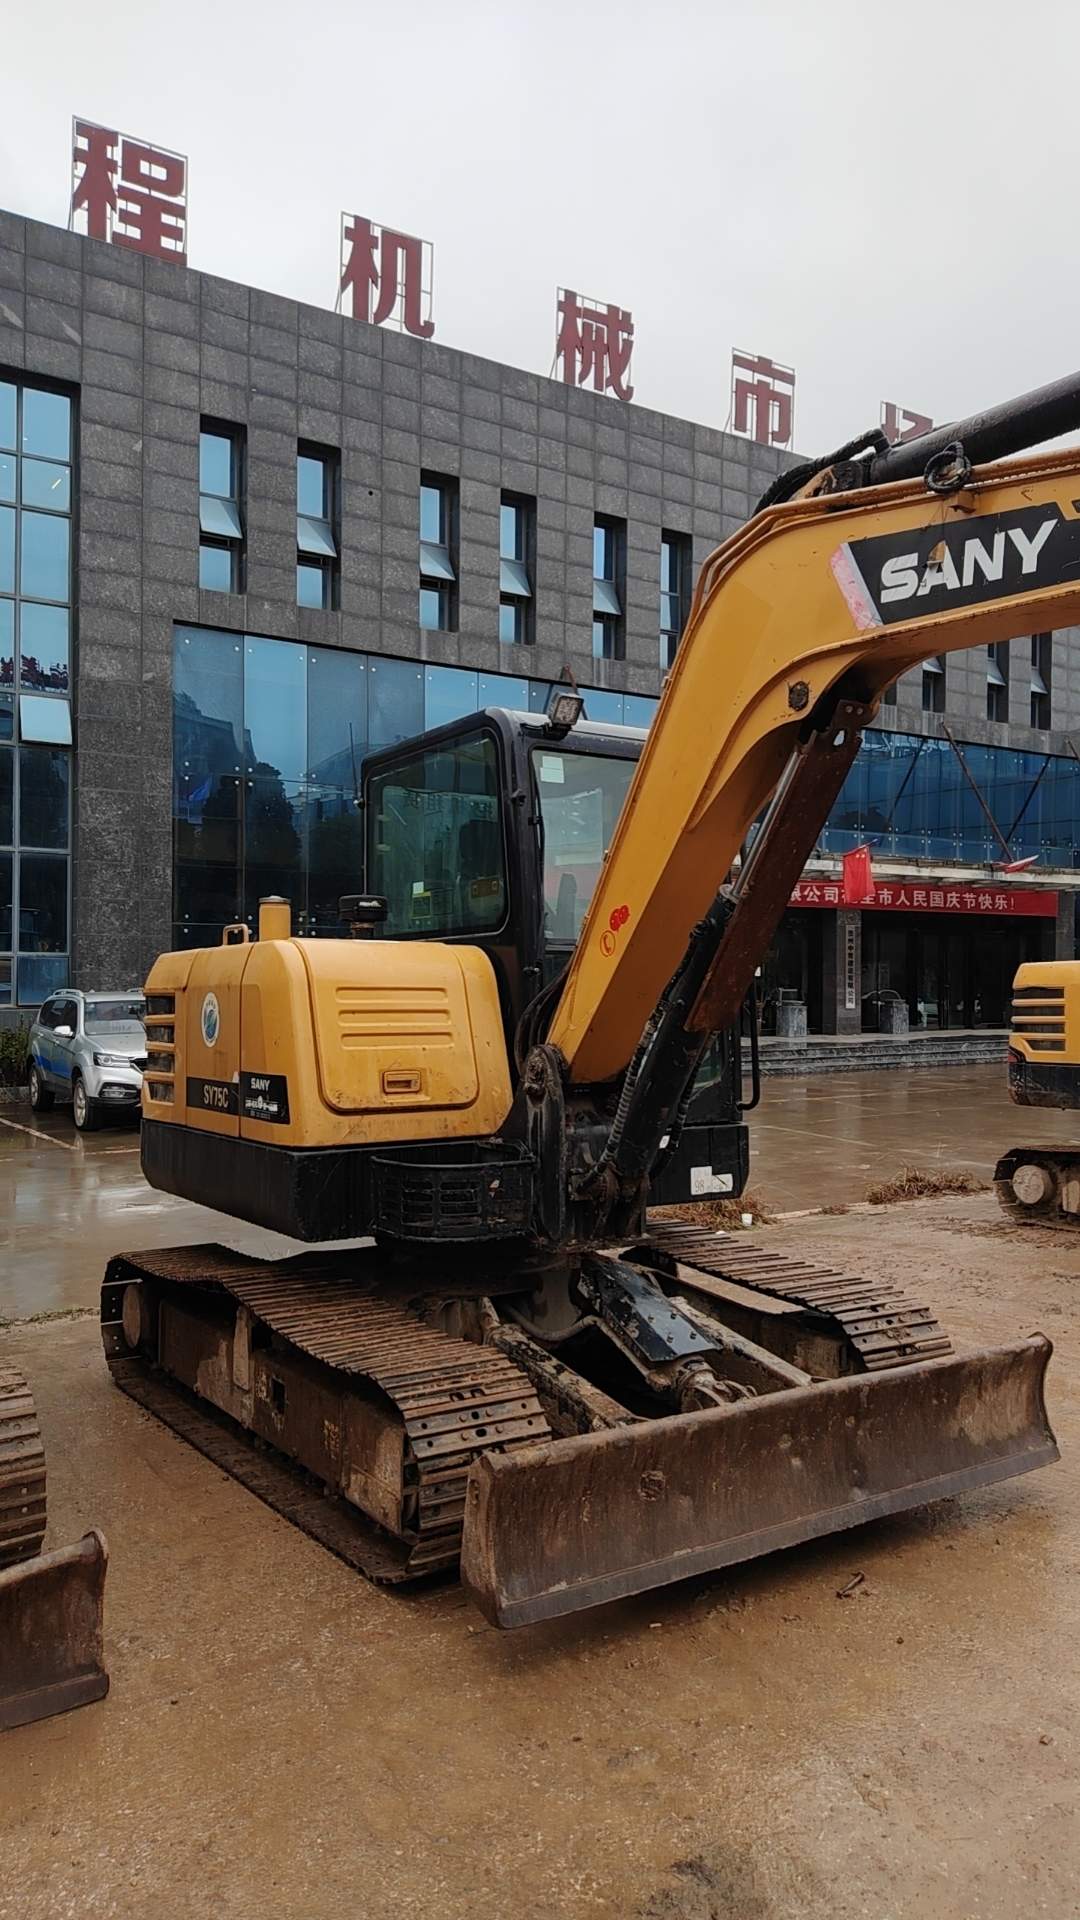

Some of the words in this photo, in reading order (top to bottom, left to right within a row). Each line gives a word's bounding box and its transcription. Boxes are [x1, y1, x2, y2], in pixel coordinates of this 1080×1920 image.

[880, 519, 1058, 604] SANY
[203, 1084, 229, 1108] SY75C
[250, 1078, 271, 1091] SANY
